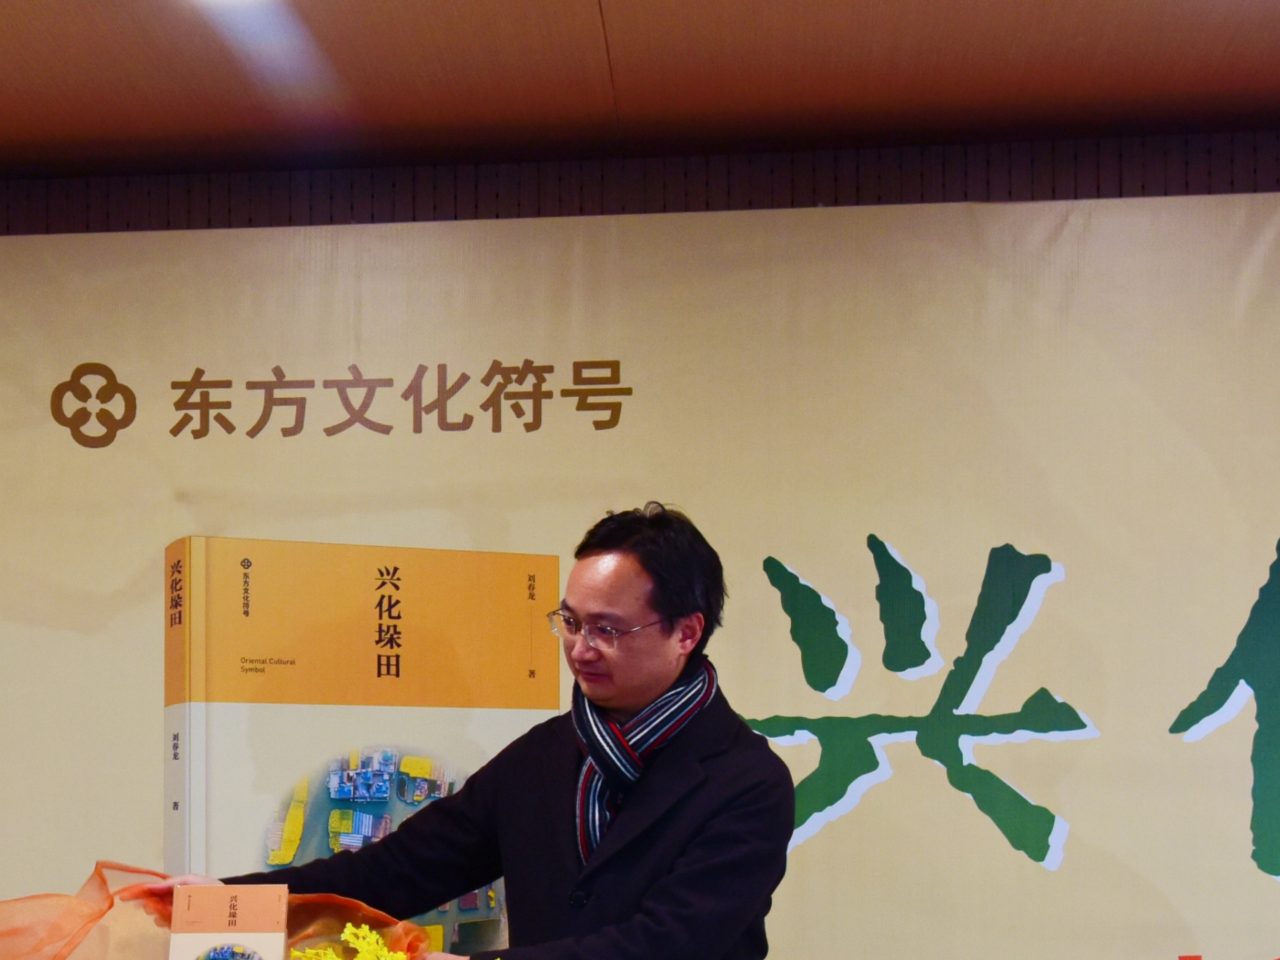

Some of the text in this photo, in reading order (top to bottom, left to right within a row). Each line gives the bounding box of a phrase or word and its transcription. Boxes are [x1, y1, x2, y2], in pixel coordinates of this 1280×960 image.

[169, 359, 633, 440] 东方文化符号
[374, 565, 403, 679] 兴化垛田
